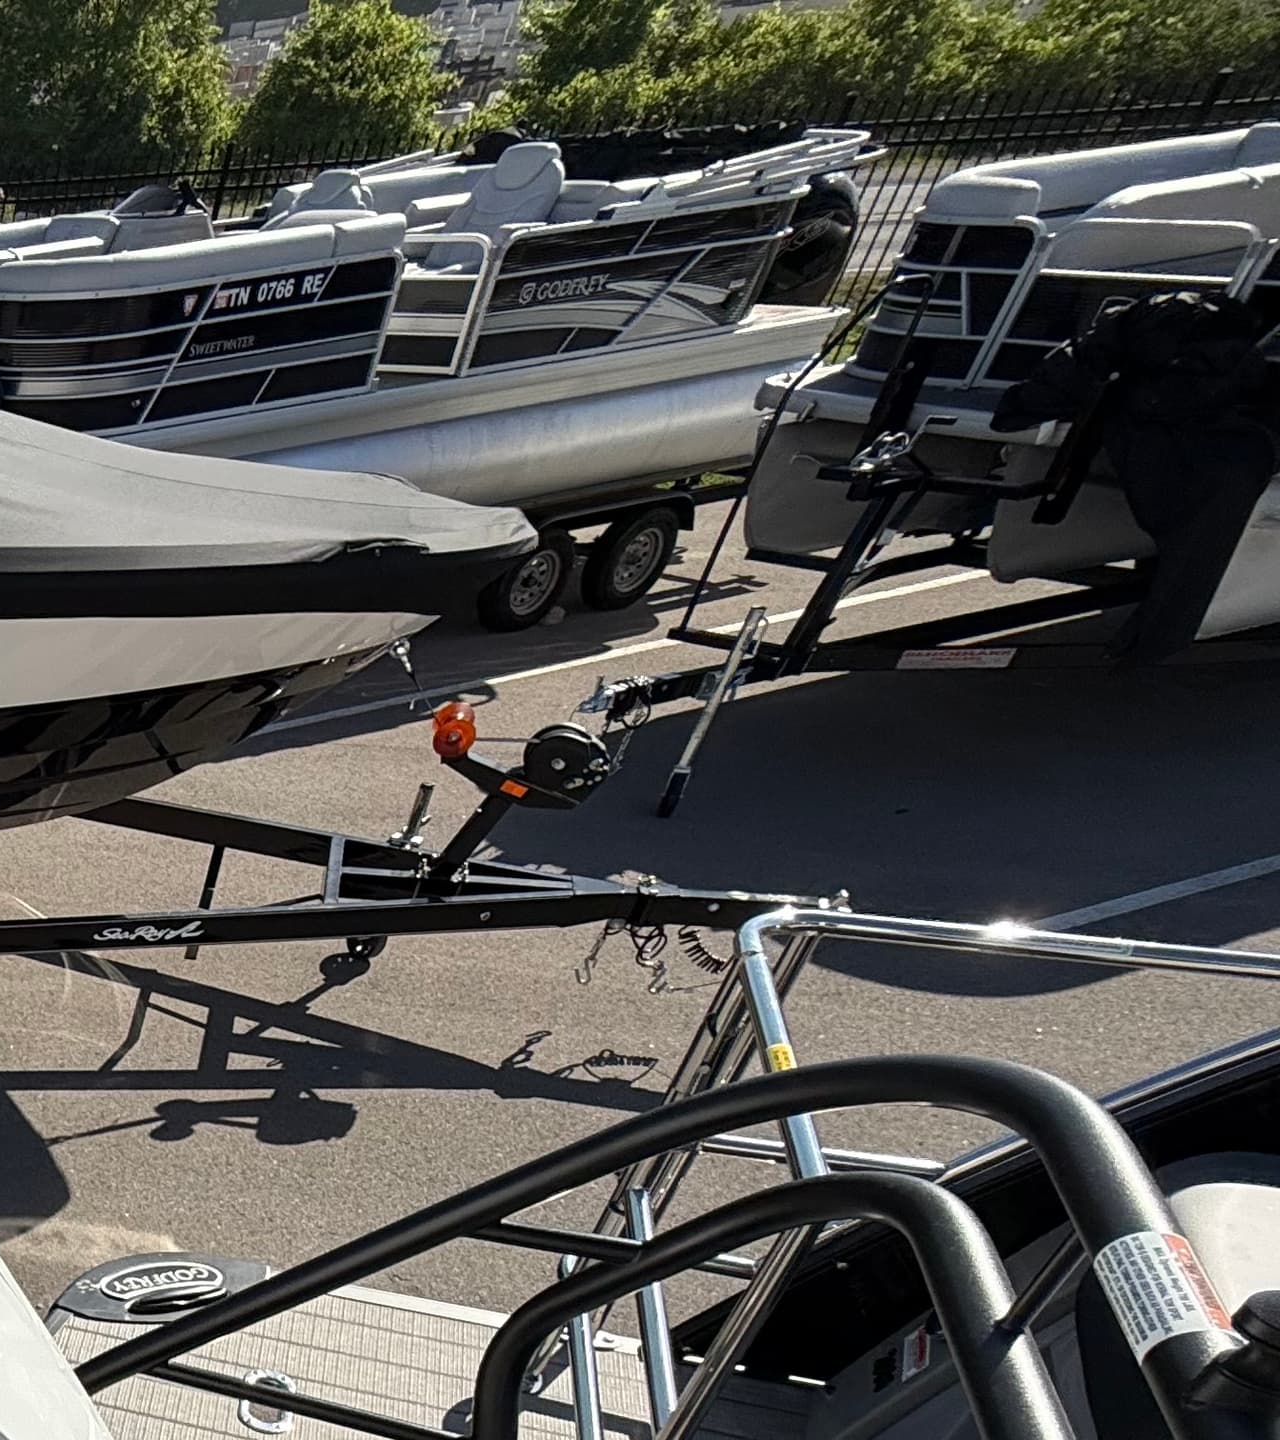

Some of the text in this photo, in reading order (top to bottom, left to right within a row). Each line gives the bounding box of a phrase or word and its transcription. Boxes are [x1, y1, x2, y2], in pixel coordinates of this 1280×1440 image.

[226, 286, 252, 307] TN
[256, 278, 296, 303] 0766
[300, 273, 325, 295] RE
[536, 273, 611, 300] GODFREY
[93, 925, 172, 942] Sea Ray
[112, 1267, 209, 1292] GODFREY
